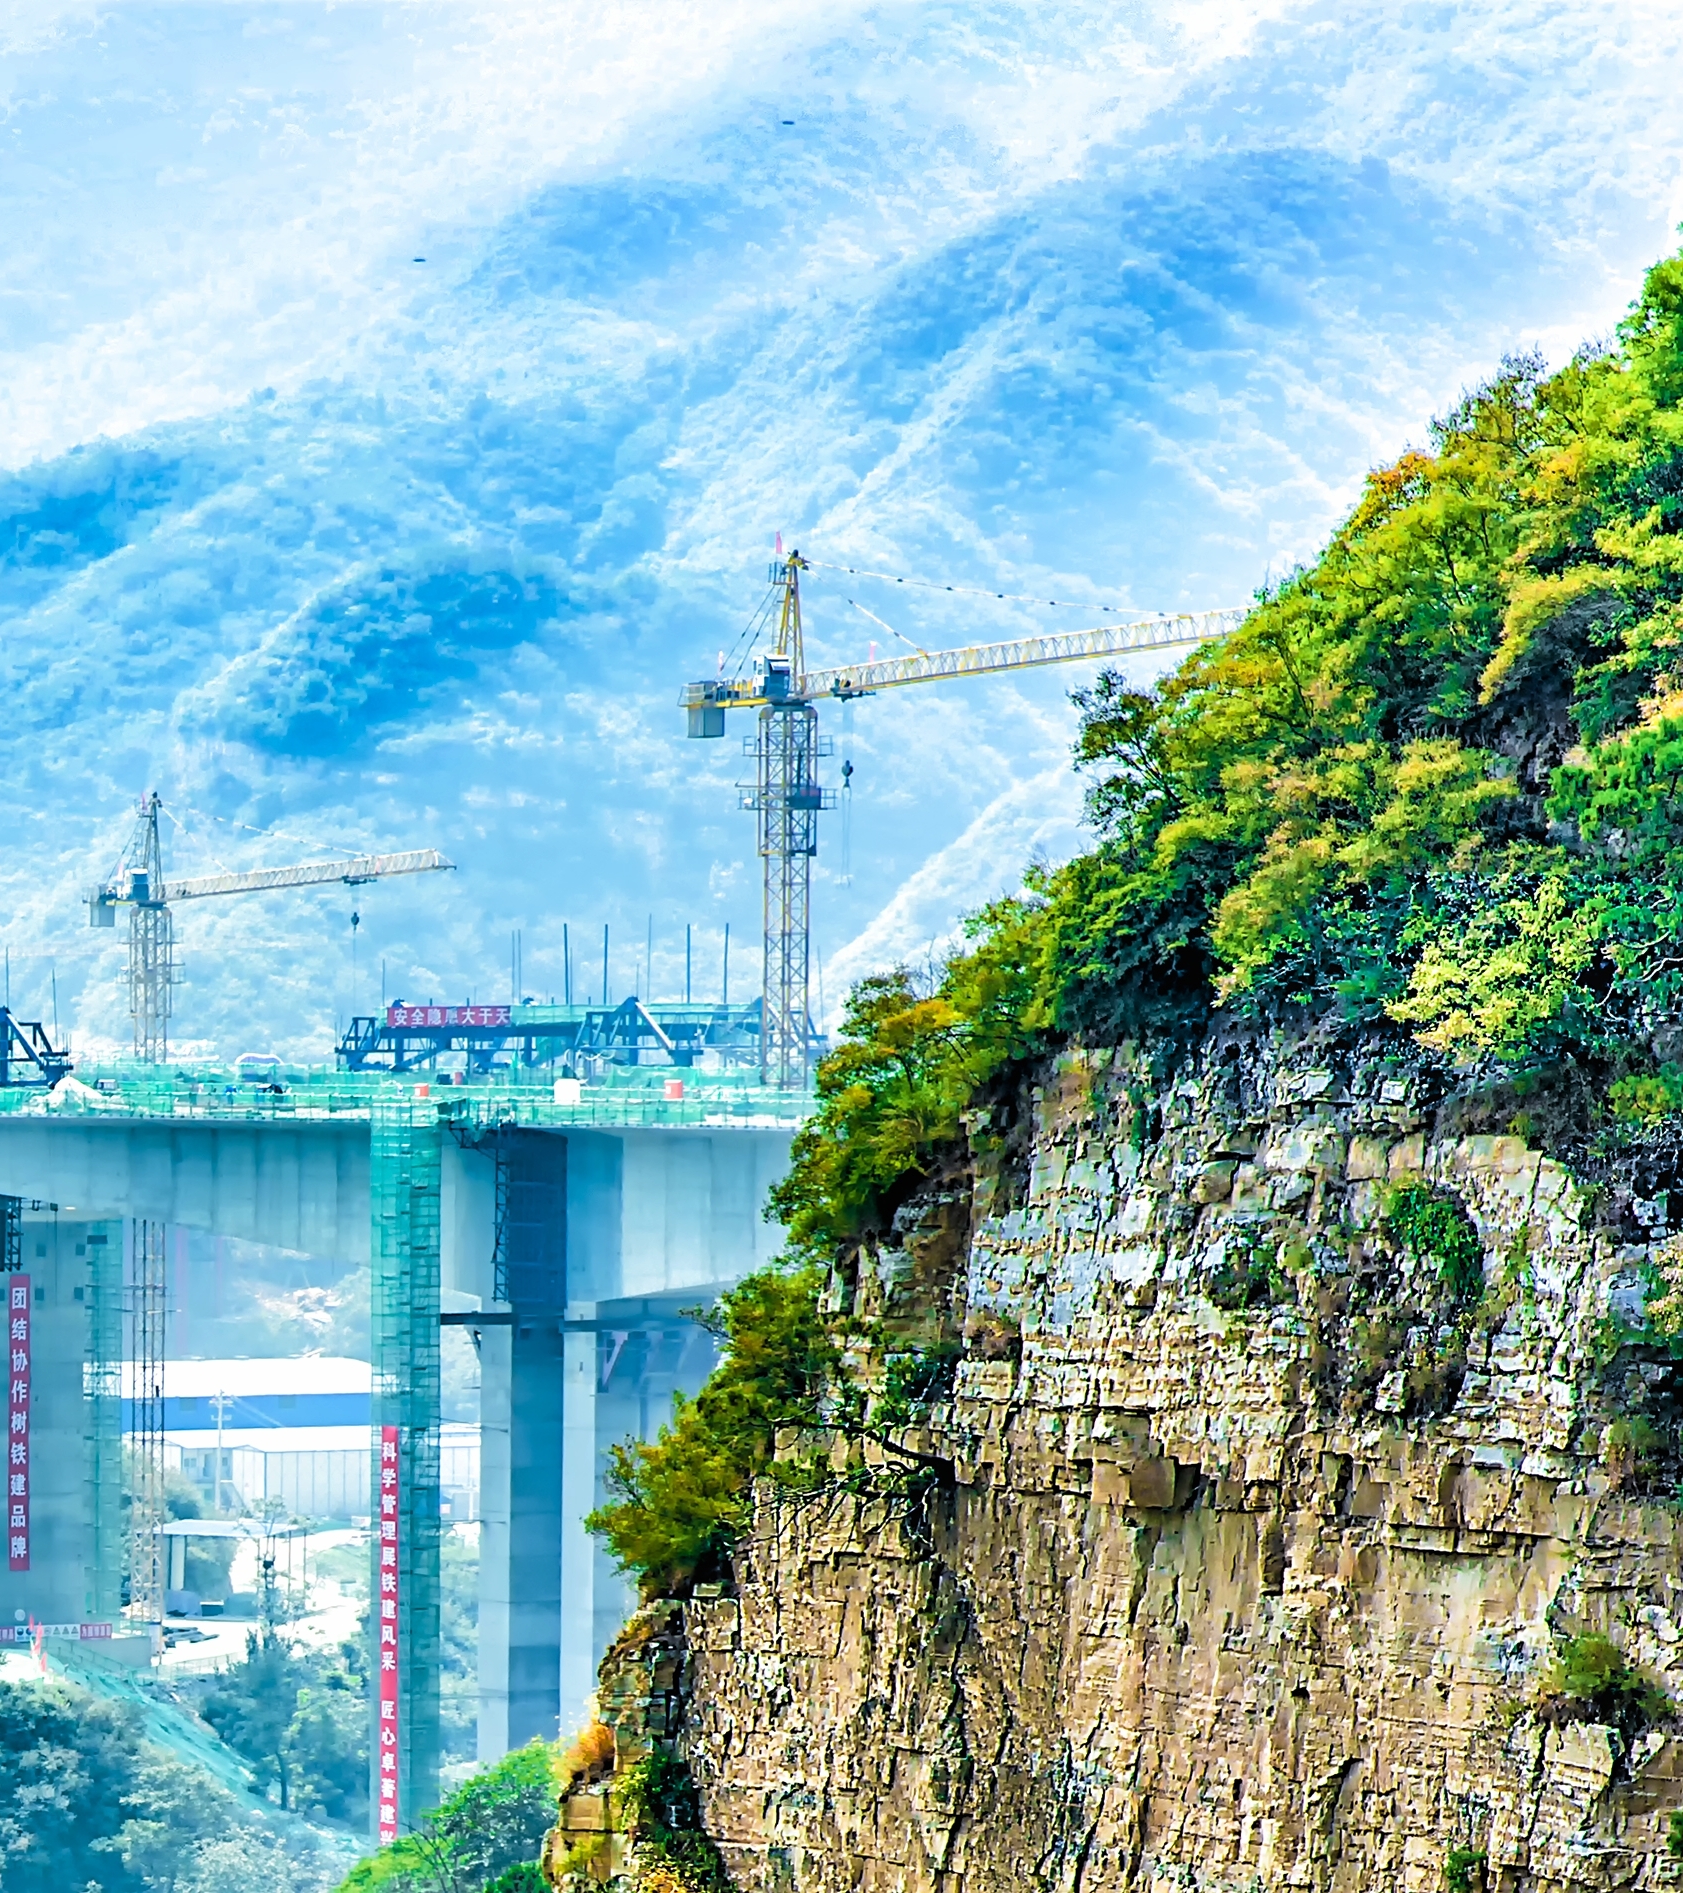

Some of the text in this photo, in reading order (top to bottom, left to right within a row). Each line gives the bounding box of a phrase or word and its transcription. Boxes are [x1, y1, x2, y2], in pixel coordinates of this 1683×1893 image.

[10, 1287, 28, 1559] 团结协作树铁建品牌
[380, 1441, 397, 1671] 科学管理展铁建风采
